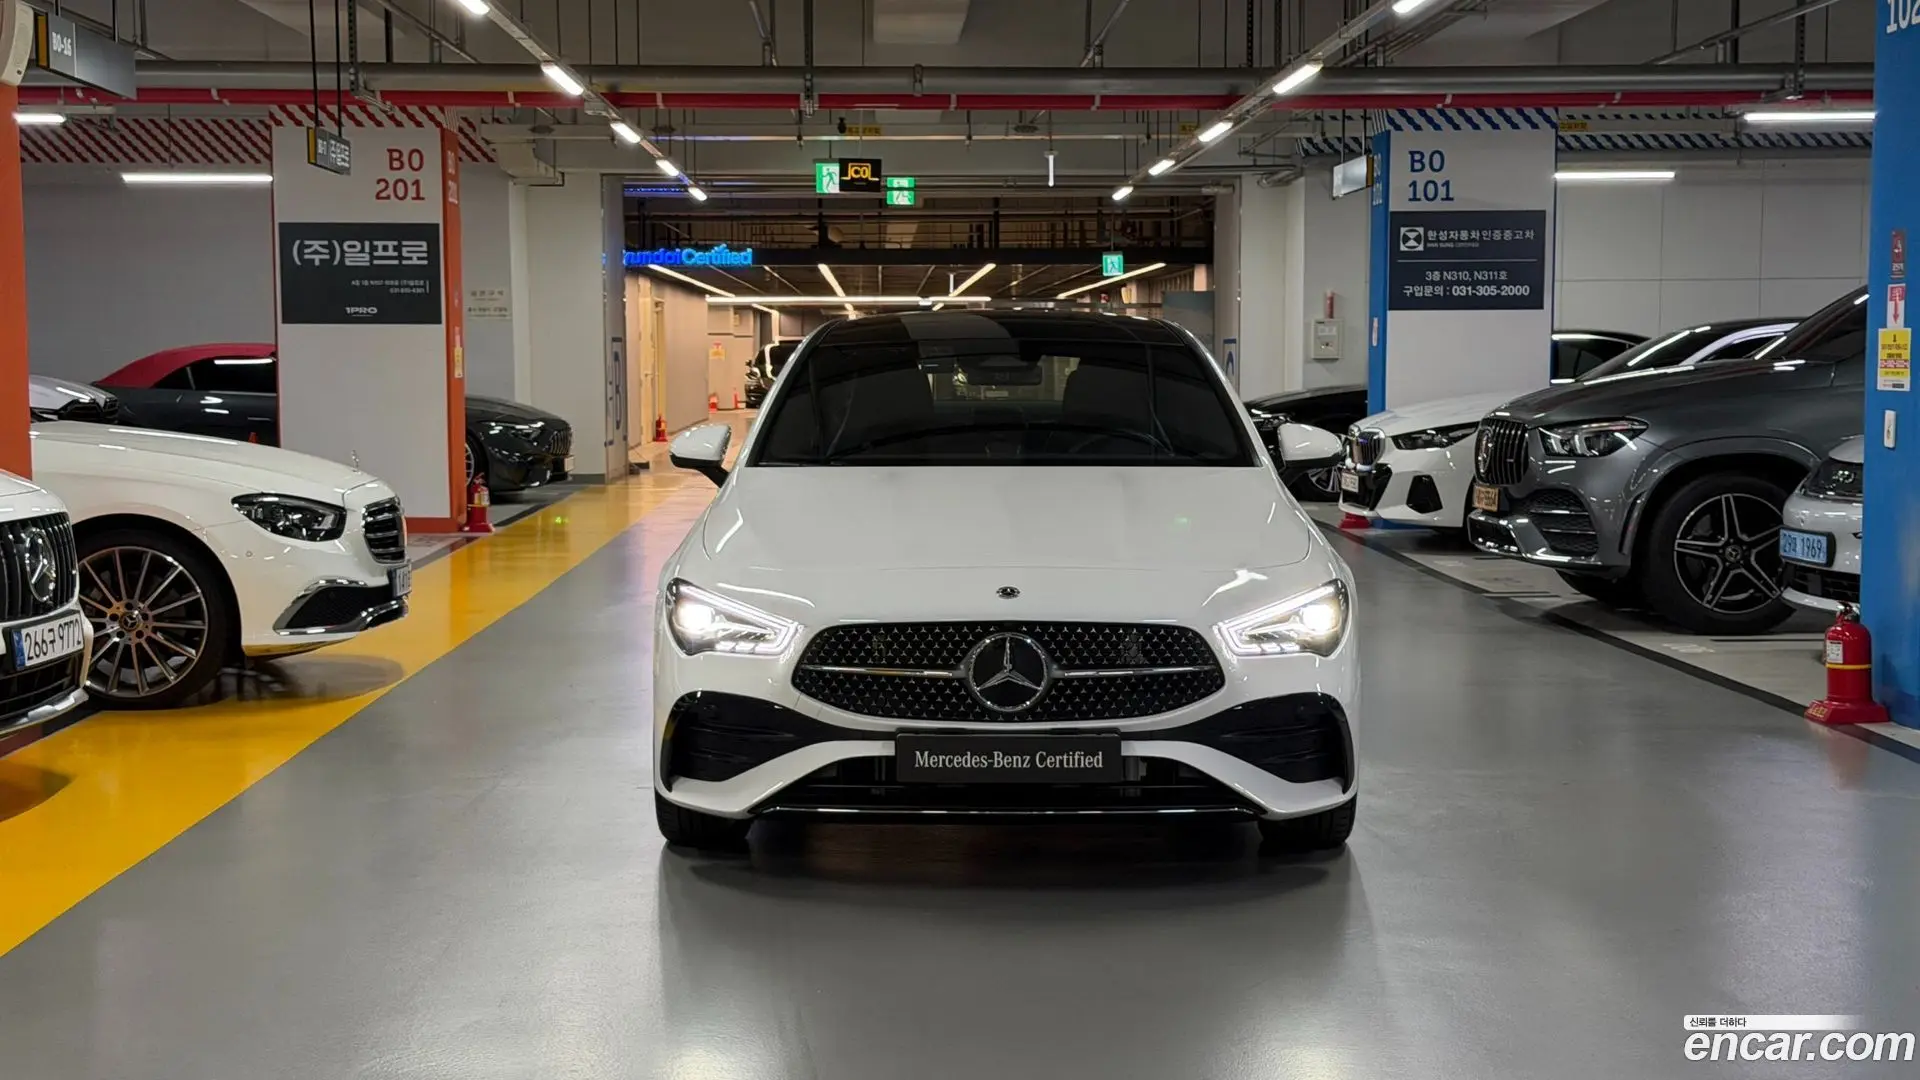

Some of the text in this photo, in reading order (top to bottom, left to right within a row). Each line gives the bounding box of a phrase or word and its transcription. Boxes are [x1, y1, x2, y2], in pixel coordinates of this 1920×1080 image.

[375, 178, 425, 201] 201
[1408, 180, 1454, 202] 101
[292, 239, 428, 266] (주)일프로
[682, 243, 752, 265] Certified
[1425, 270, 1508, 282] 3층 N310, N311호
[1403, 285, 1444, 297] 구입문의
[1451, 284, 1530, 297] 031-305-2000
[1800, 536, 1823, 560] 1969
[25, 618, 82, 661] 266구 9772
[914, 750, 1104, 768] Mercedes-Benz Certified
